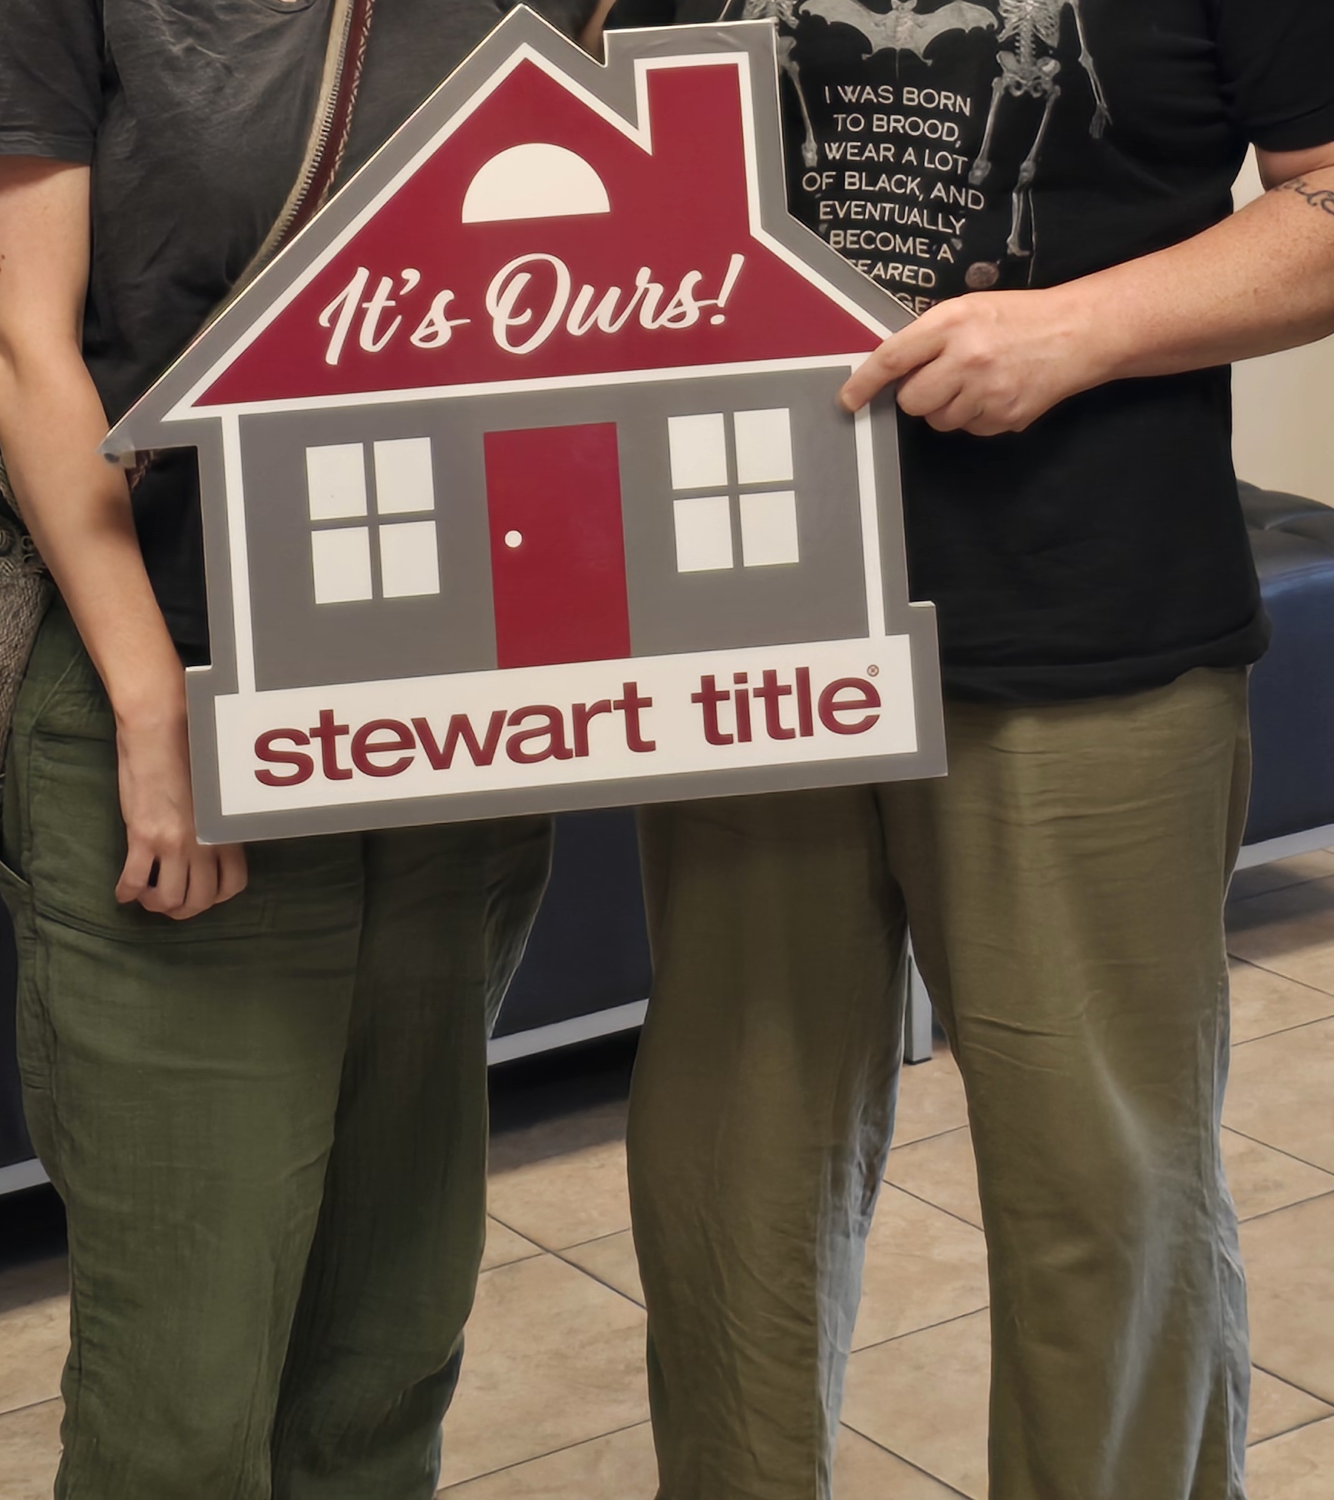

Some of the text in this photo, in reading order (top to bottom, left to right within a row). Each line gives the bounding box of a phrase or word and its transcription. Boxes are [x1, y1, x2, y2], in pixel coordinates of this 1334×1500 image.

[824, 85, 971, 117] I WAS BORN
[833, 113, 962, 149] TO BROOD,
[824, 141, 969, 175] WEAR A LOT
[802, 171, 985, 210] OF BLACK, AND
[819, 200, 966, 235] EVENTUALLY
[829, 229, 955, 264] BECOME A
[847, 258, 936, 288] EARED
[318, 252, 745, 366] It's Ours!
[253, 680, 657, 787] stewart
